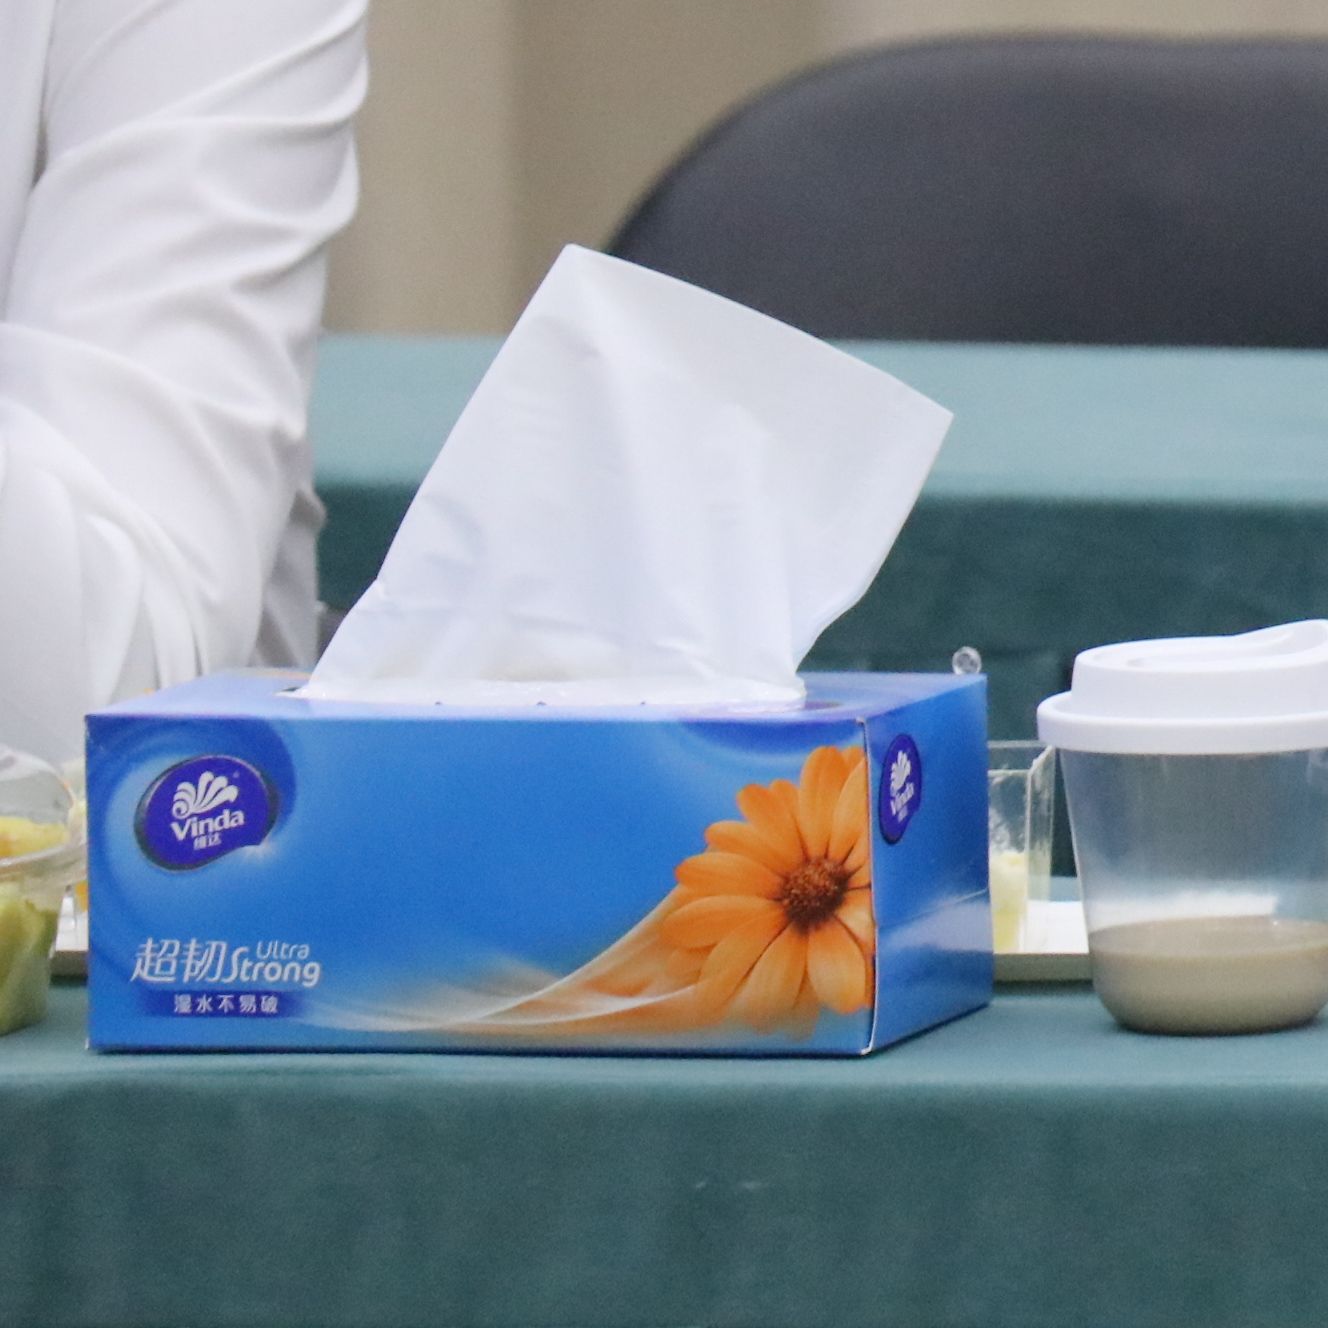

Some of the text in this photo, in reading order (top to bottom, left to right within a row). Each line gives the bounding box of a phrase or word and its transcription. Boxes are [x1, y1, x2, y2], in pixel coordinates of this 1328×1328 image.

[170, 808, 246, 842] Vinda
[130, 937, 227, 984] 超韧
[256, 940, 310, 960] Ultra
[222, 946, 321, 989] Strong
[174, 993, 278, 1015] 湿水不易破
